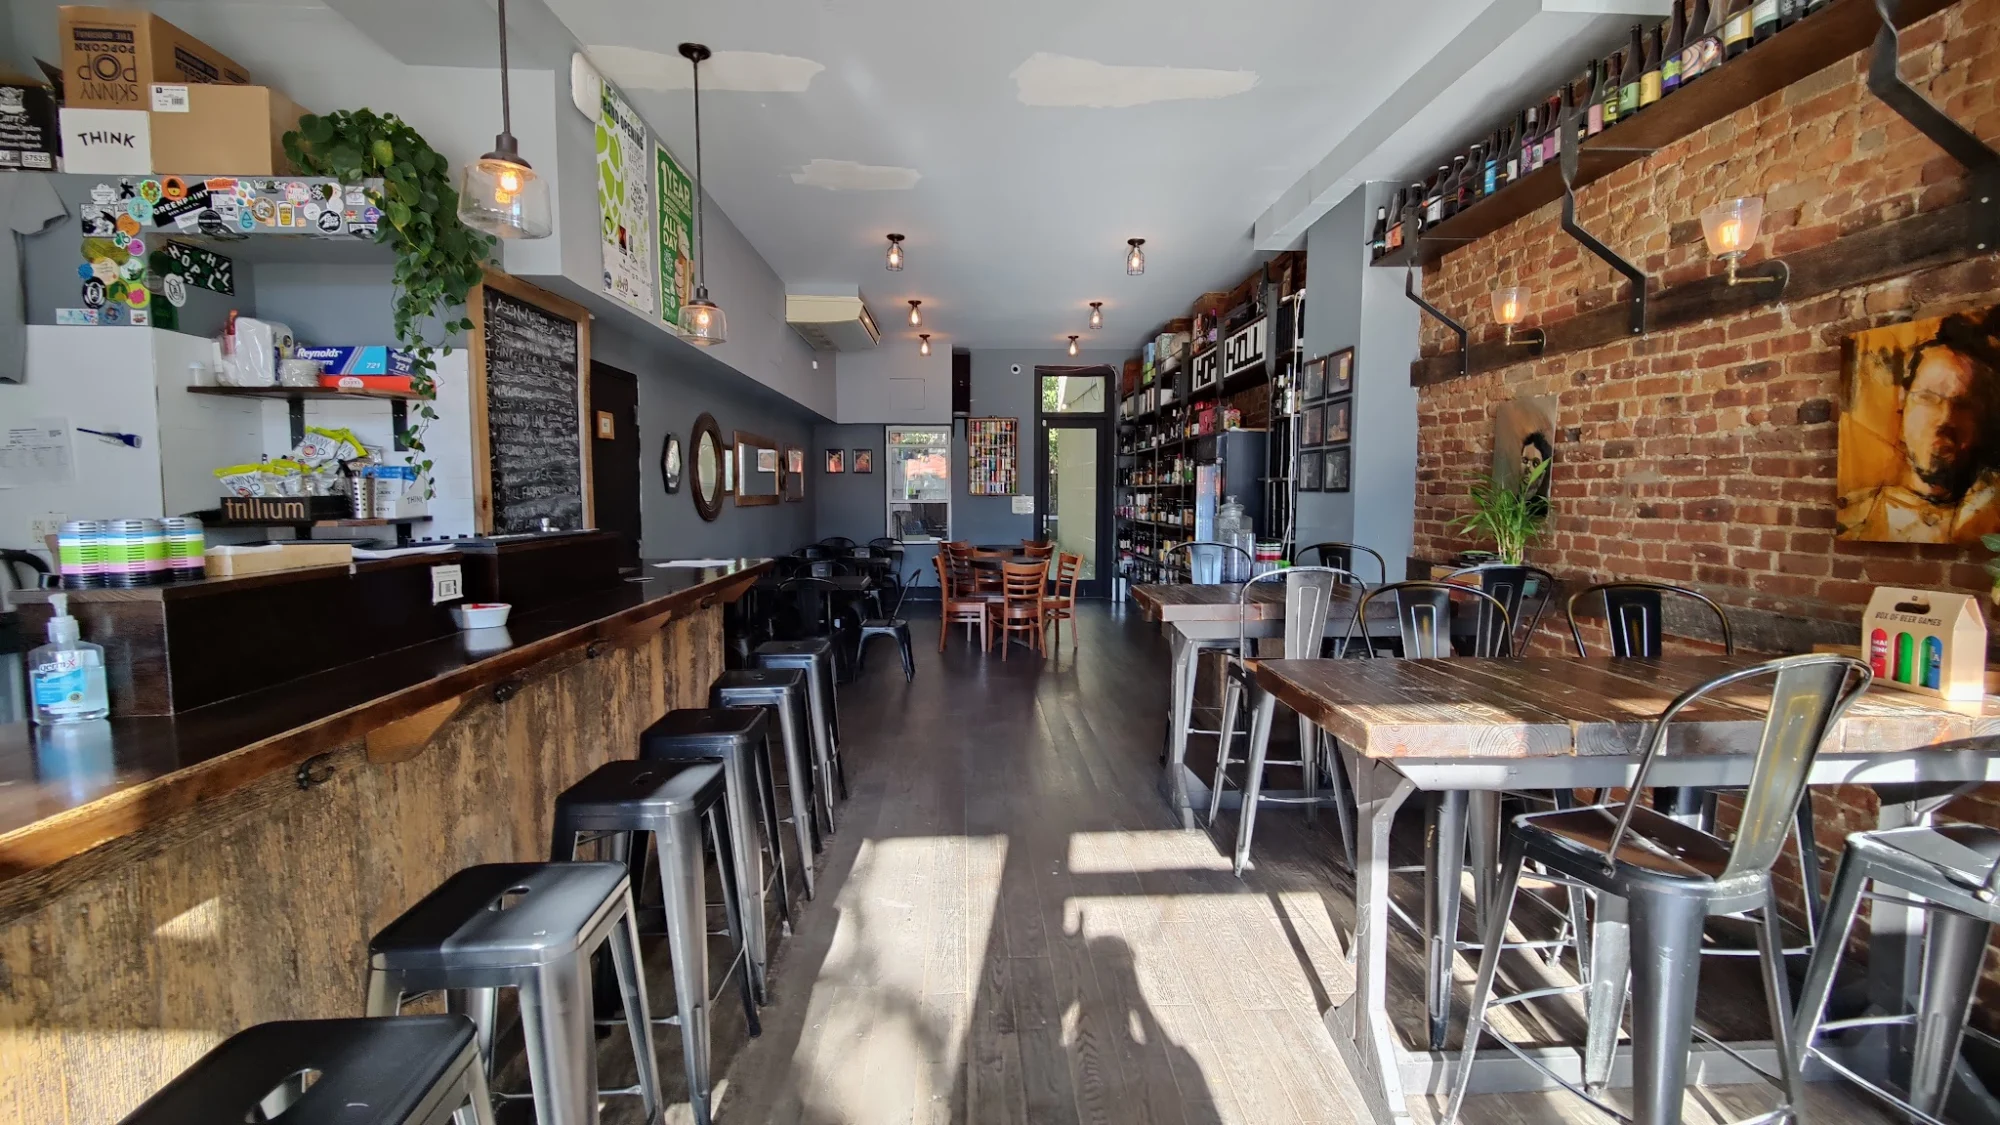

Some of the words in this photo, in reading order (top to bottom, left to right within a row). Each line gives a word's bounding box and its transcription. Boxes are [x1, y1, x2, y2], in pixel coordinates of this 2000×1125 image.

[75, 43, 136, 54] POPCORN
[78, 54, 138, 82] POP
[78, 131, 136, 148] THINK
[620, 115, 644, 150] OPENING
[667, 165, 691, 210] YEAR
[663, 220, 677, 239] ALL
[663, 233, 678, 250] DAY
[297, 347, 339, 359] Reynolds
[396, 362, 409, 371] 721
[224, 498, 305, 519] trillium
[1875, 611, 1888, 619] BOX
[1900, 614, 1917, 623] BEER
[1918, 616, 1942, 627] GAMES
